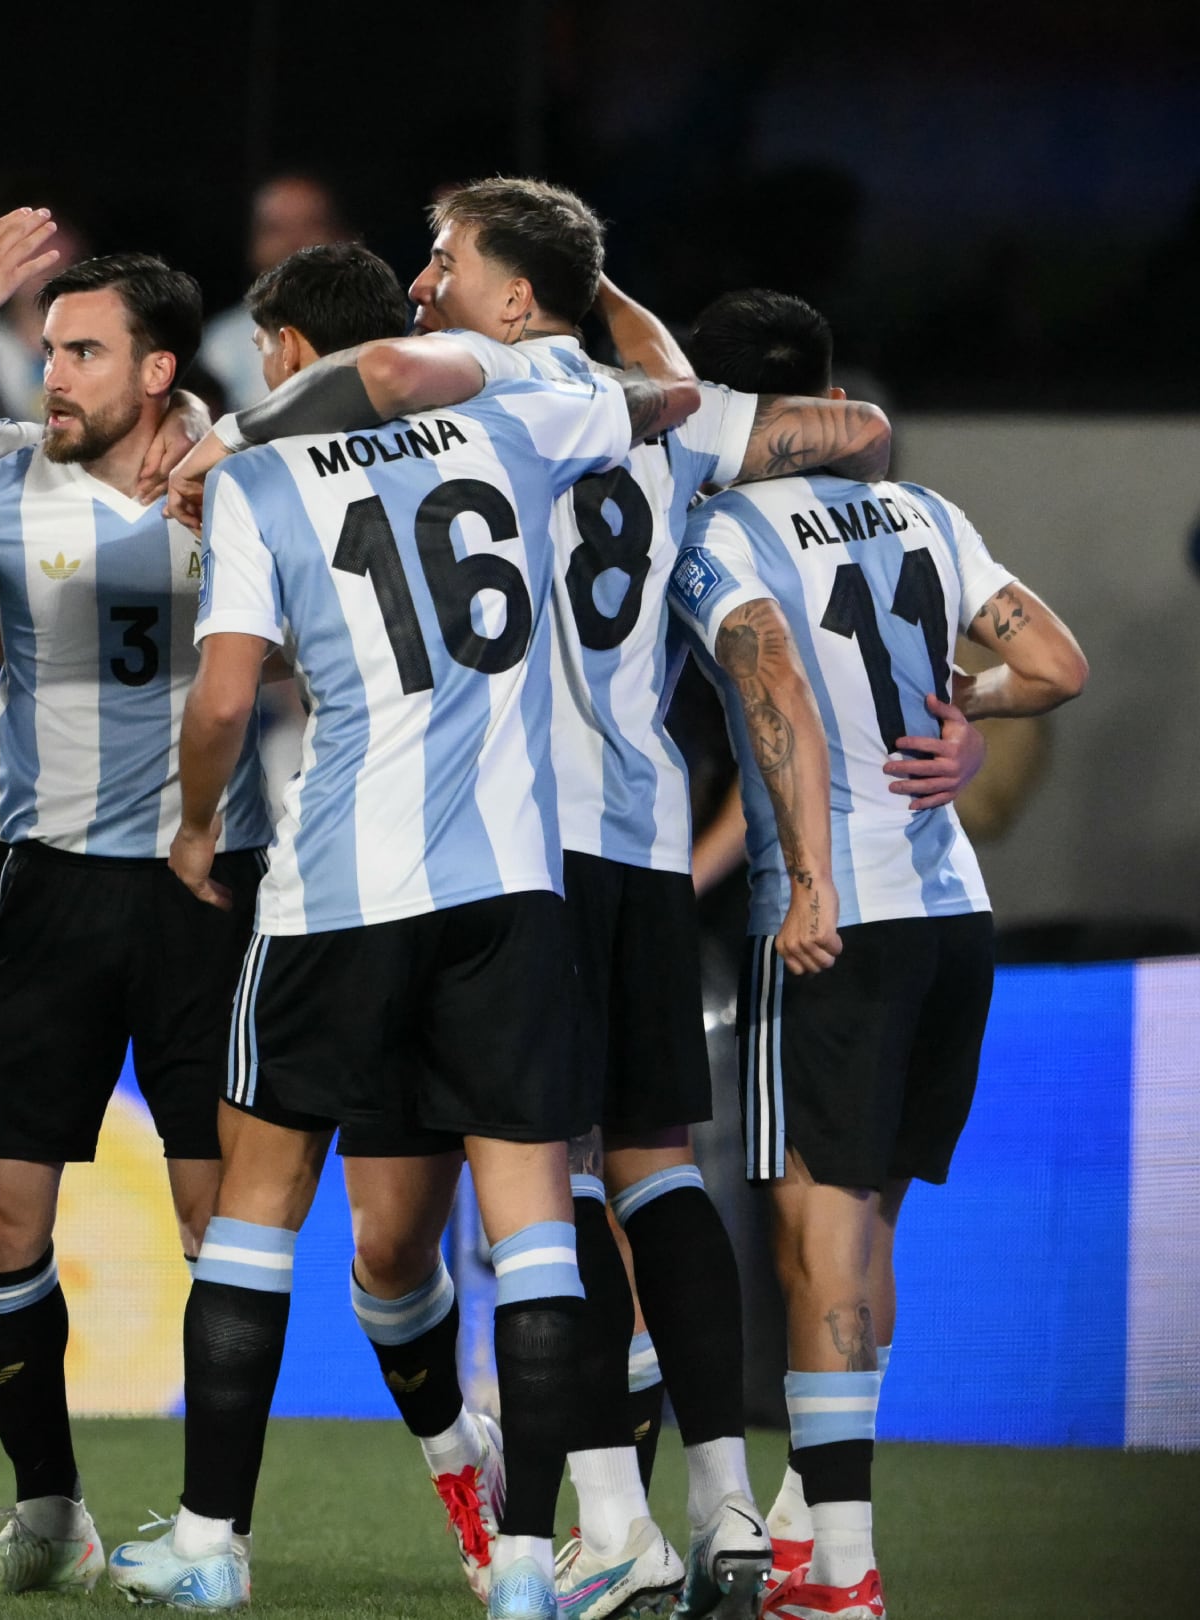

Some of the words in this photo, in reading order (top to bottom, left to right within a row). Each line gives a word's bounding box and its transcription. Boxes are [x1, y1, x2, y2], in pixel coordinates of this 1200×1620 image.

[307, 419, 468, 478] MOLINA
[110, 605, 159, 687] 3
[332, 478, 533, 696] 16
[565, 465, 654, 651] 8
[819, 546, 951, 756] 11
